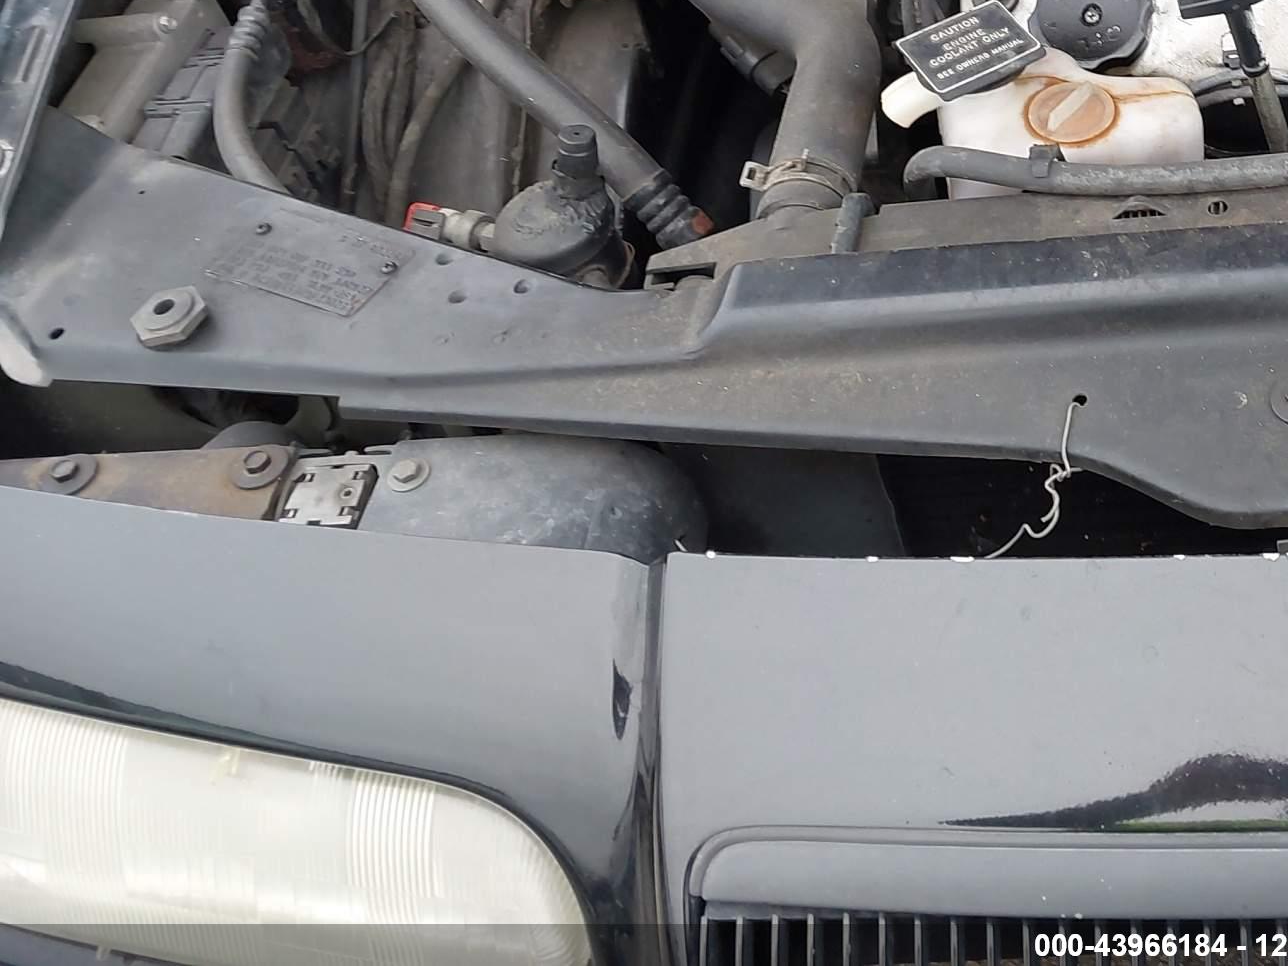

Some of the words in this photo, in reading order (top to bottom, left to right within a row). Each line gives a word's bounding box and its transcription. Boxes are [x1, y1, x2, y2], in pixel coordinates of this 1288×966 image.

[930, 16, 980, 42] CAUTION
[942, 28, 987, 51] ENGINE
[929, 41, 979, 67] COOLANT
[982, 27, 1010, 44] ONLY
[936, 69, 955, 80] SEE
[991, 38, 1025, 55] MANUAL
